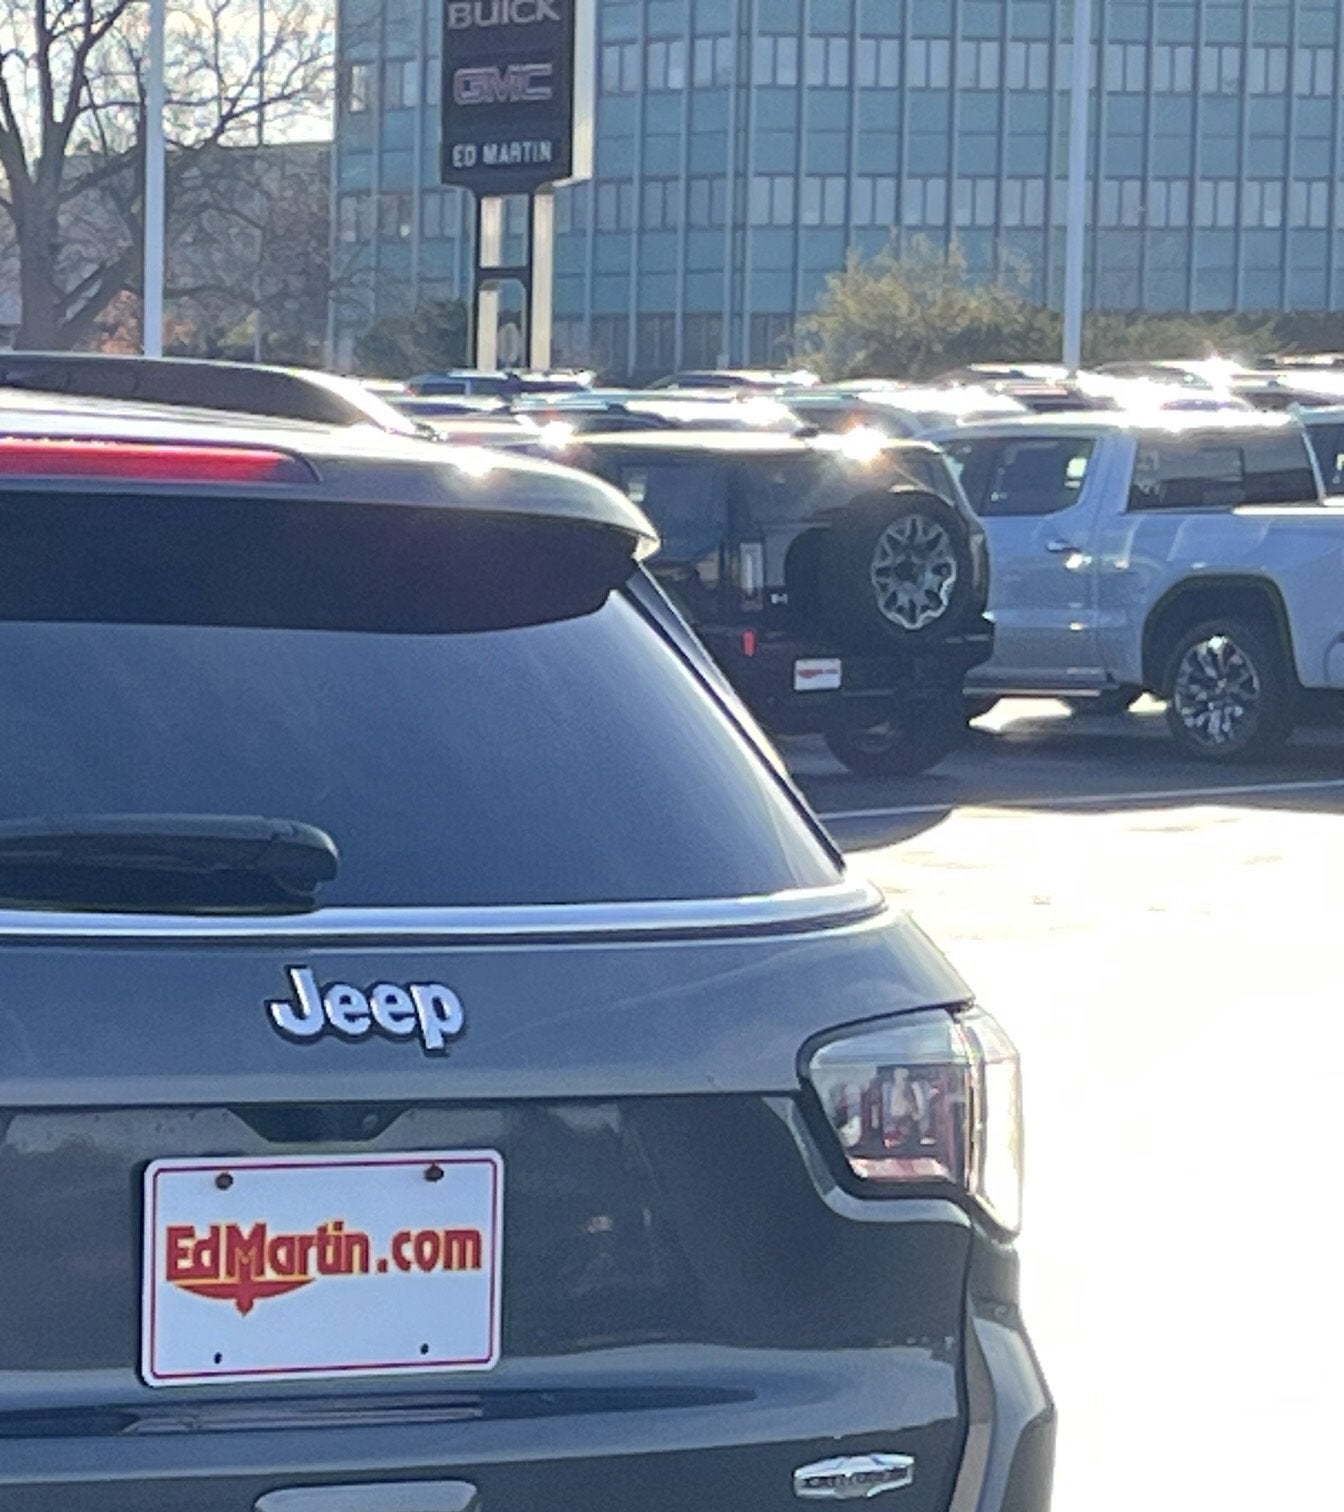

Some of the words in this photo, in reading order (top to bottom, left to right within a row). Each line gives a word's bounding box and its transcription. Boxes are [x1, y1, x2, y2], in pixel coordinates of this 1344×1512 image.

[447, 0, 561, 29] BUICK
[453, 63, 553, 105] GMC
[451, 143, 477, 168] ED
[482, 140, 553, 165] MARTIN
[268, 966, 464, 1052] Jeep
[165, 1220, 483, 1283] EdMartin.com
